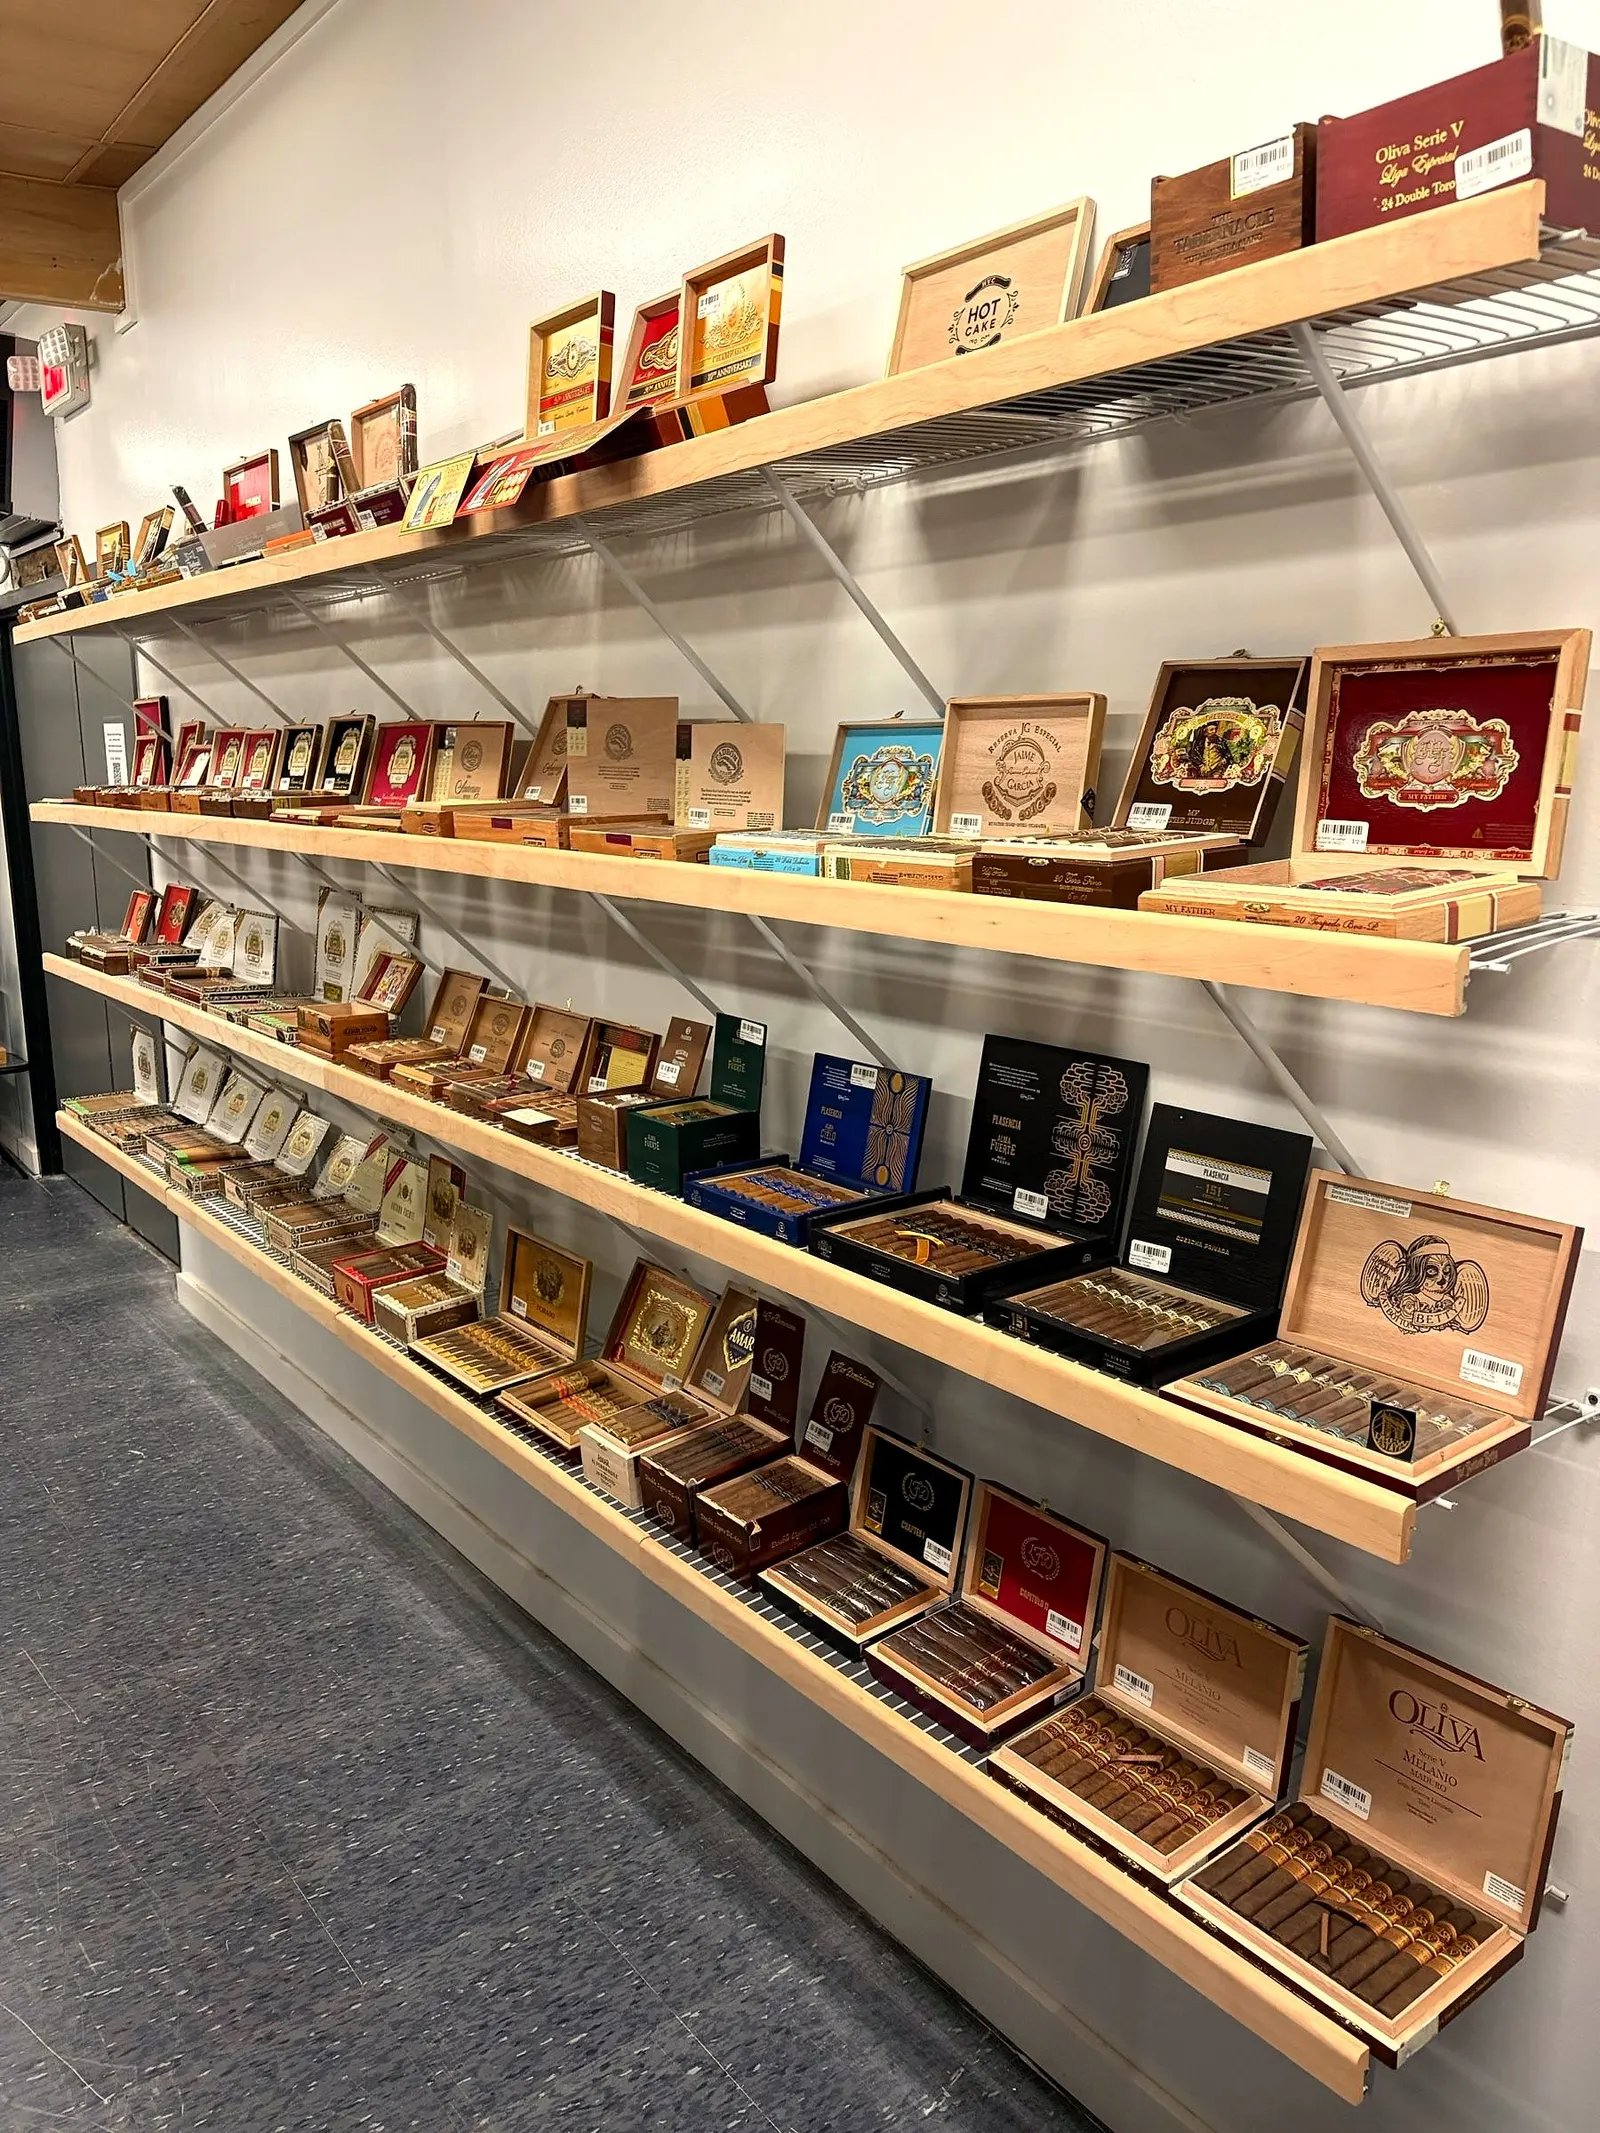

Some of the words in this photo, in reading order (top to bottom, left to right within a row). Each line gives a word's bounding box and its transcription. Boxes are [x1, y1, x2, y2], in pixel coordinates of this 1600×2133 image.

[1375, 142, 1411, 164] Oliva
[1413, 128, 1448, 151] Serie
[1450, 120, 1464, 138] V
[1395, 186, 1431, 207] Double
[1432, 179, 1456, 195] Toro
[968, 298, 1001, 324] HOT
[965, 318, 997, 337] CAKE
[1013, 750, 1036, 764] JAIME
[1185, 816, 1216, 826] JUDGE
[1165, 903, 1180, 912] MY
[1181, 905, 1216, 916] FATHER
[989, 1138, 1016, 1156] FUERTE
[1203, 1168, 1230, 1181] PLASENCIA
[1165, 1607, 1244, 1670] OLIVA
[1388, 1689, 1487, 1763] OLIVA
[1402, 1749, 1458, 1787] MELANIO
[1440, 1758, 1447, 1767] V
[1410, 1768, 1447, 1793] MADURO
